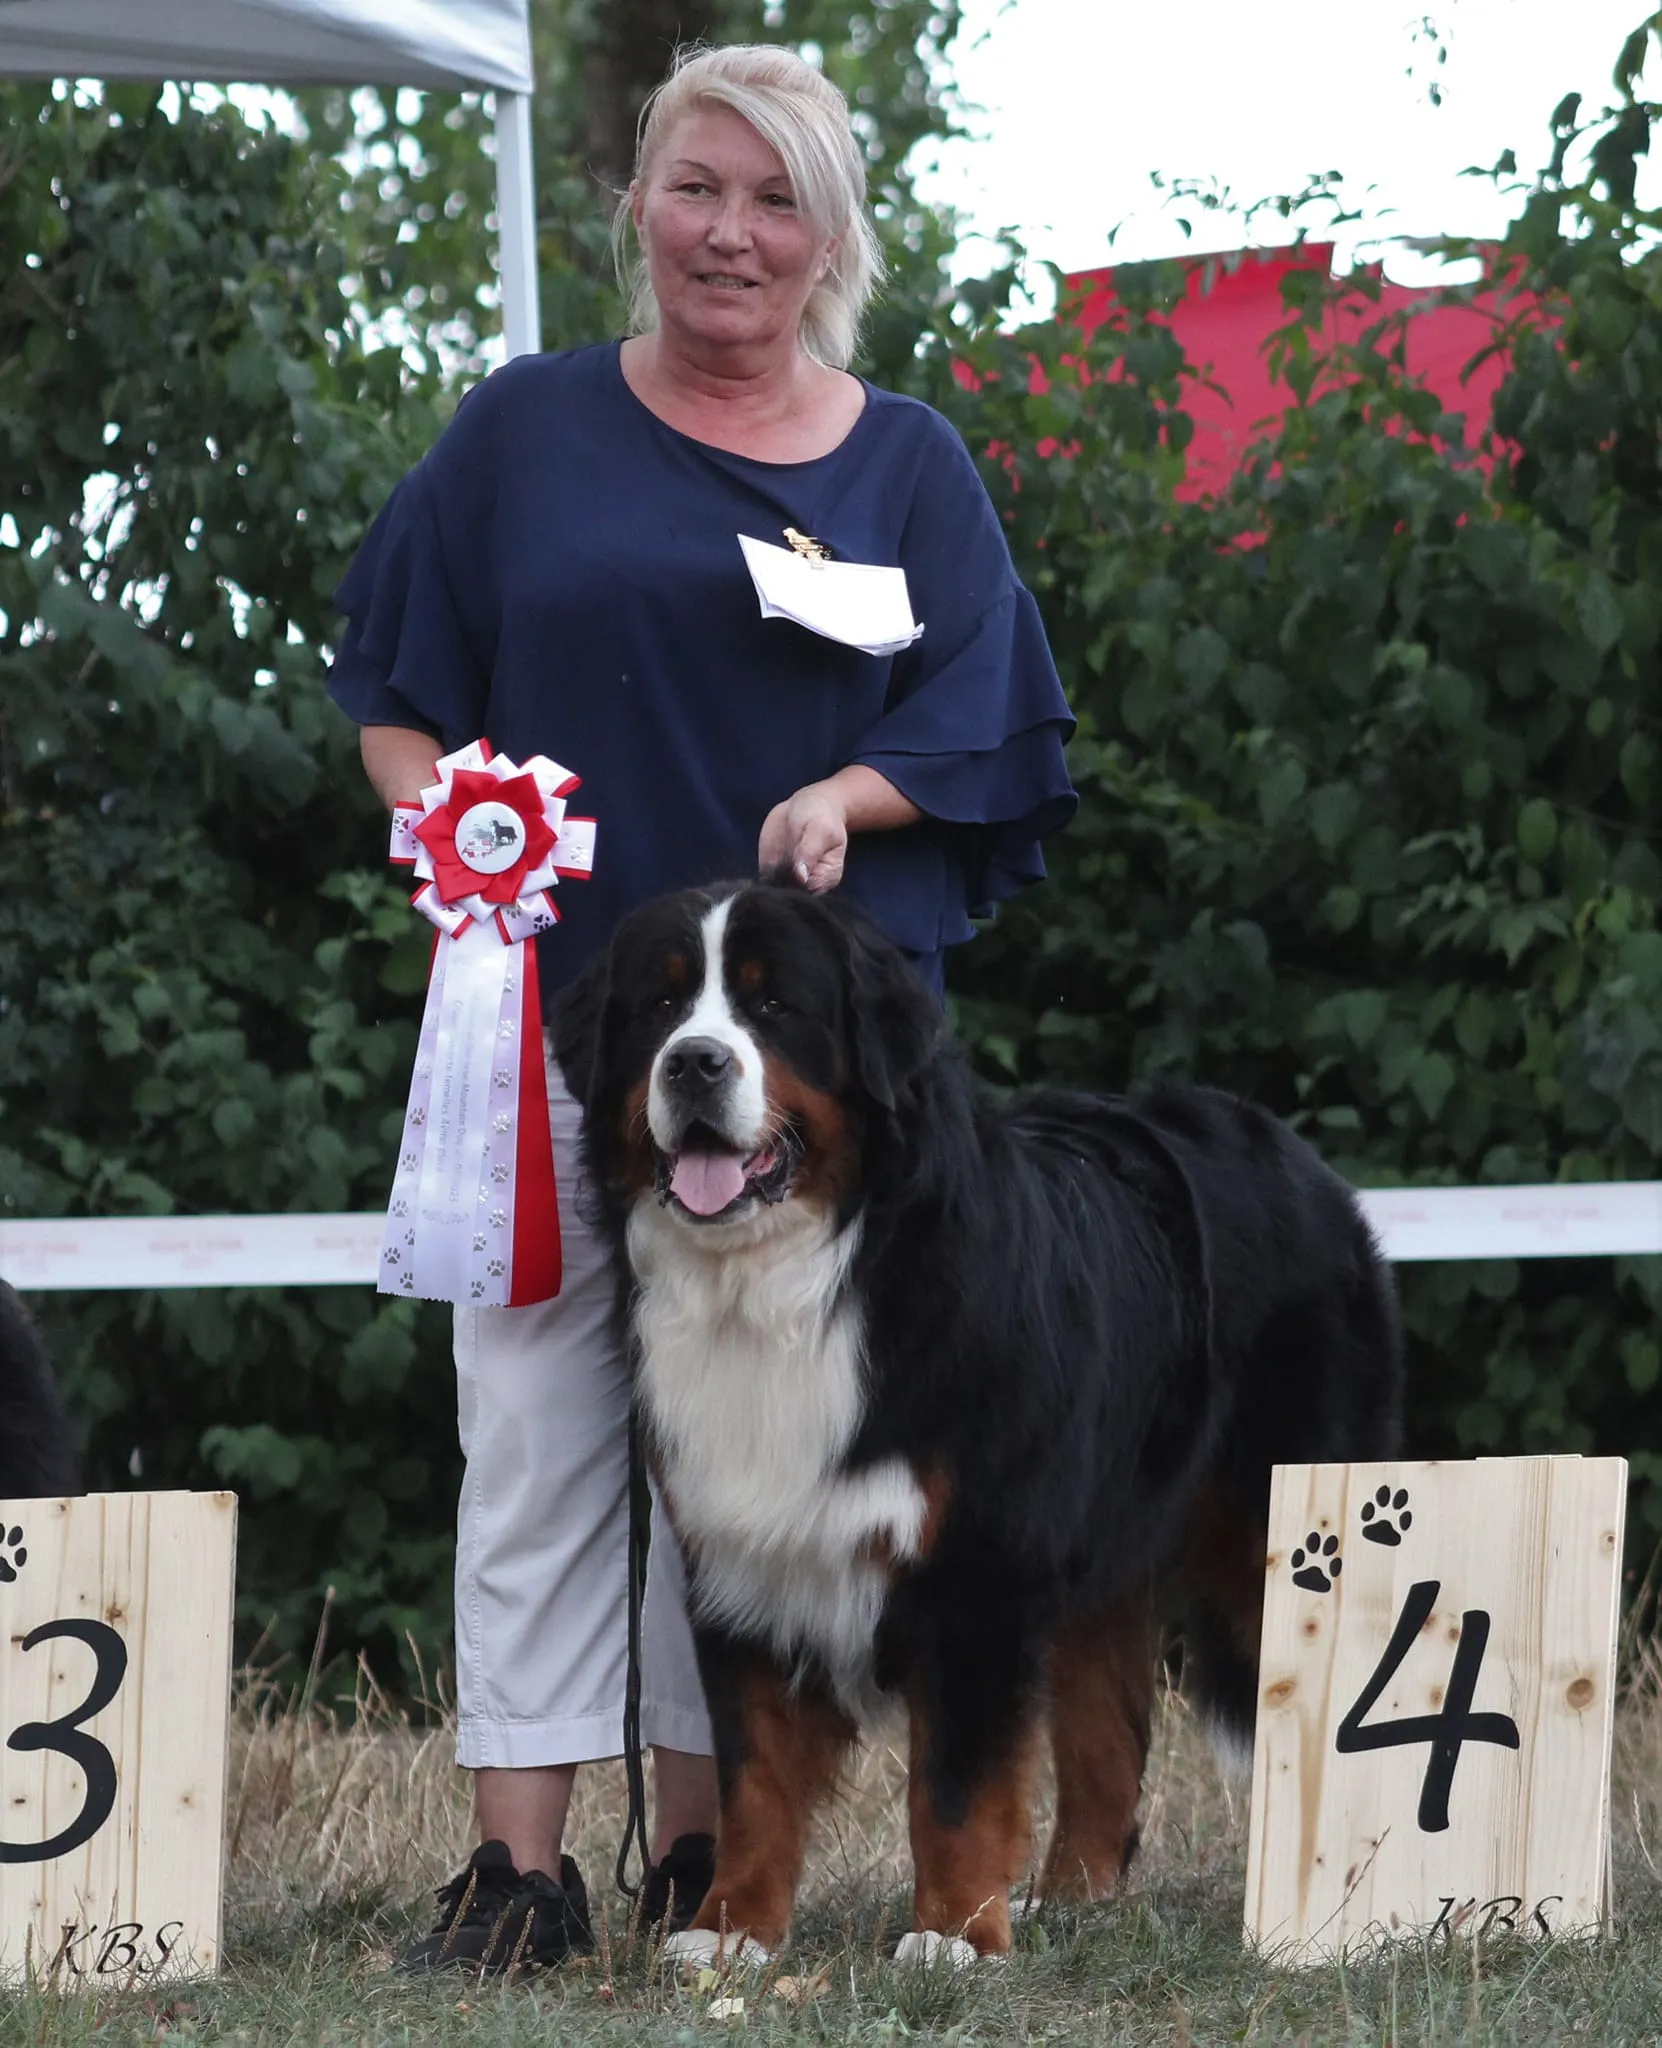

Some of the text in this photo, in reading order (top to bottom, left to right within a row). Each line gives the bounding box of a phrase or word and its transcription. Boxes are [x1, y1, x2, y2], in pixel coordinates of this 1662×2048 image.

[441, 1075, 453, 1115] femelles
[457, 1084, 470, 1126] Mountain
[1336, 1580, 1519, 1831] 4
[0, 1618, 128, 1863] 3
[1428, 1895, 1563, 1940] KBS
[50, 1920, 184, 1974] KBS
